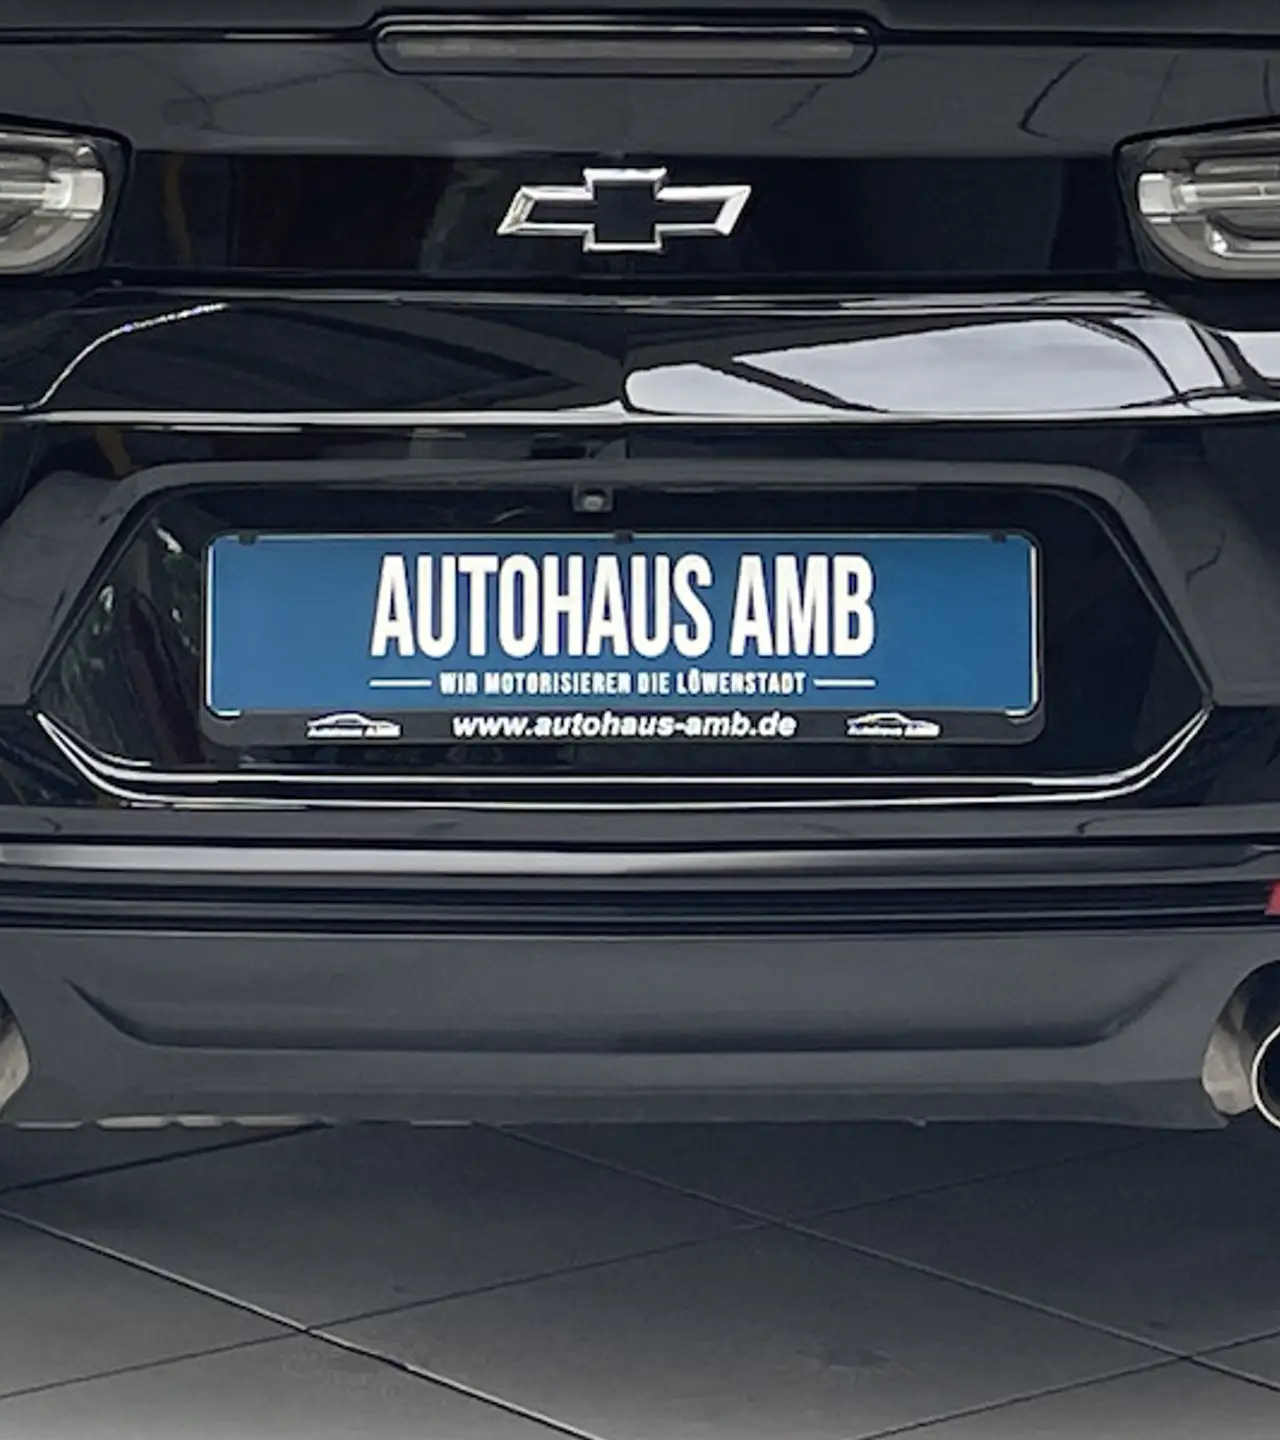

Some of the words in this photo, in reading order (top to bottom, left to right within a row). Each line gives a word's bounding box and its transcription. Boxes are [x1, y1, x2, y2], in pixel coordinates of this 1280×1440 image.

[371, 554, 712, 658] AUTOHAUS
[730, 554, 875, 657] AMB
[439, 672, 478, 694] WIR
[484, 672, 631, 694] MOTORISIEREN
[637, 672, 670, 694] DIE
[676, 668, 806, 694] LÖWENSTADT
[452, 710, 797, 738] www.autohaus-amb.de
